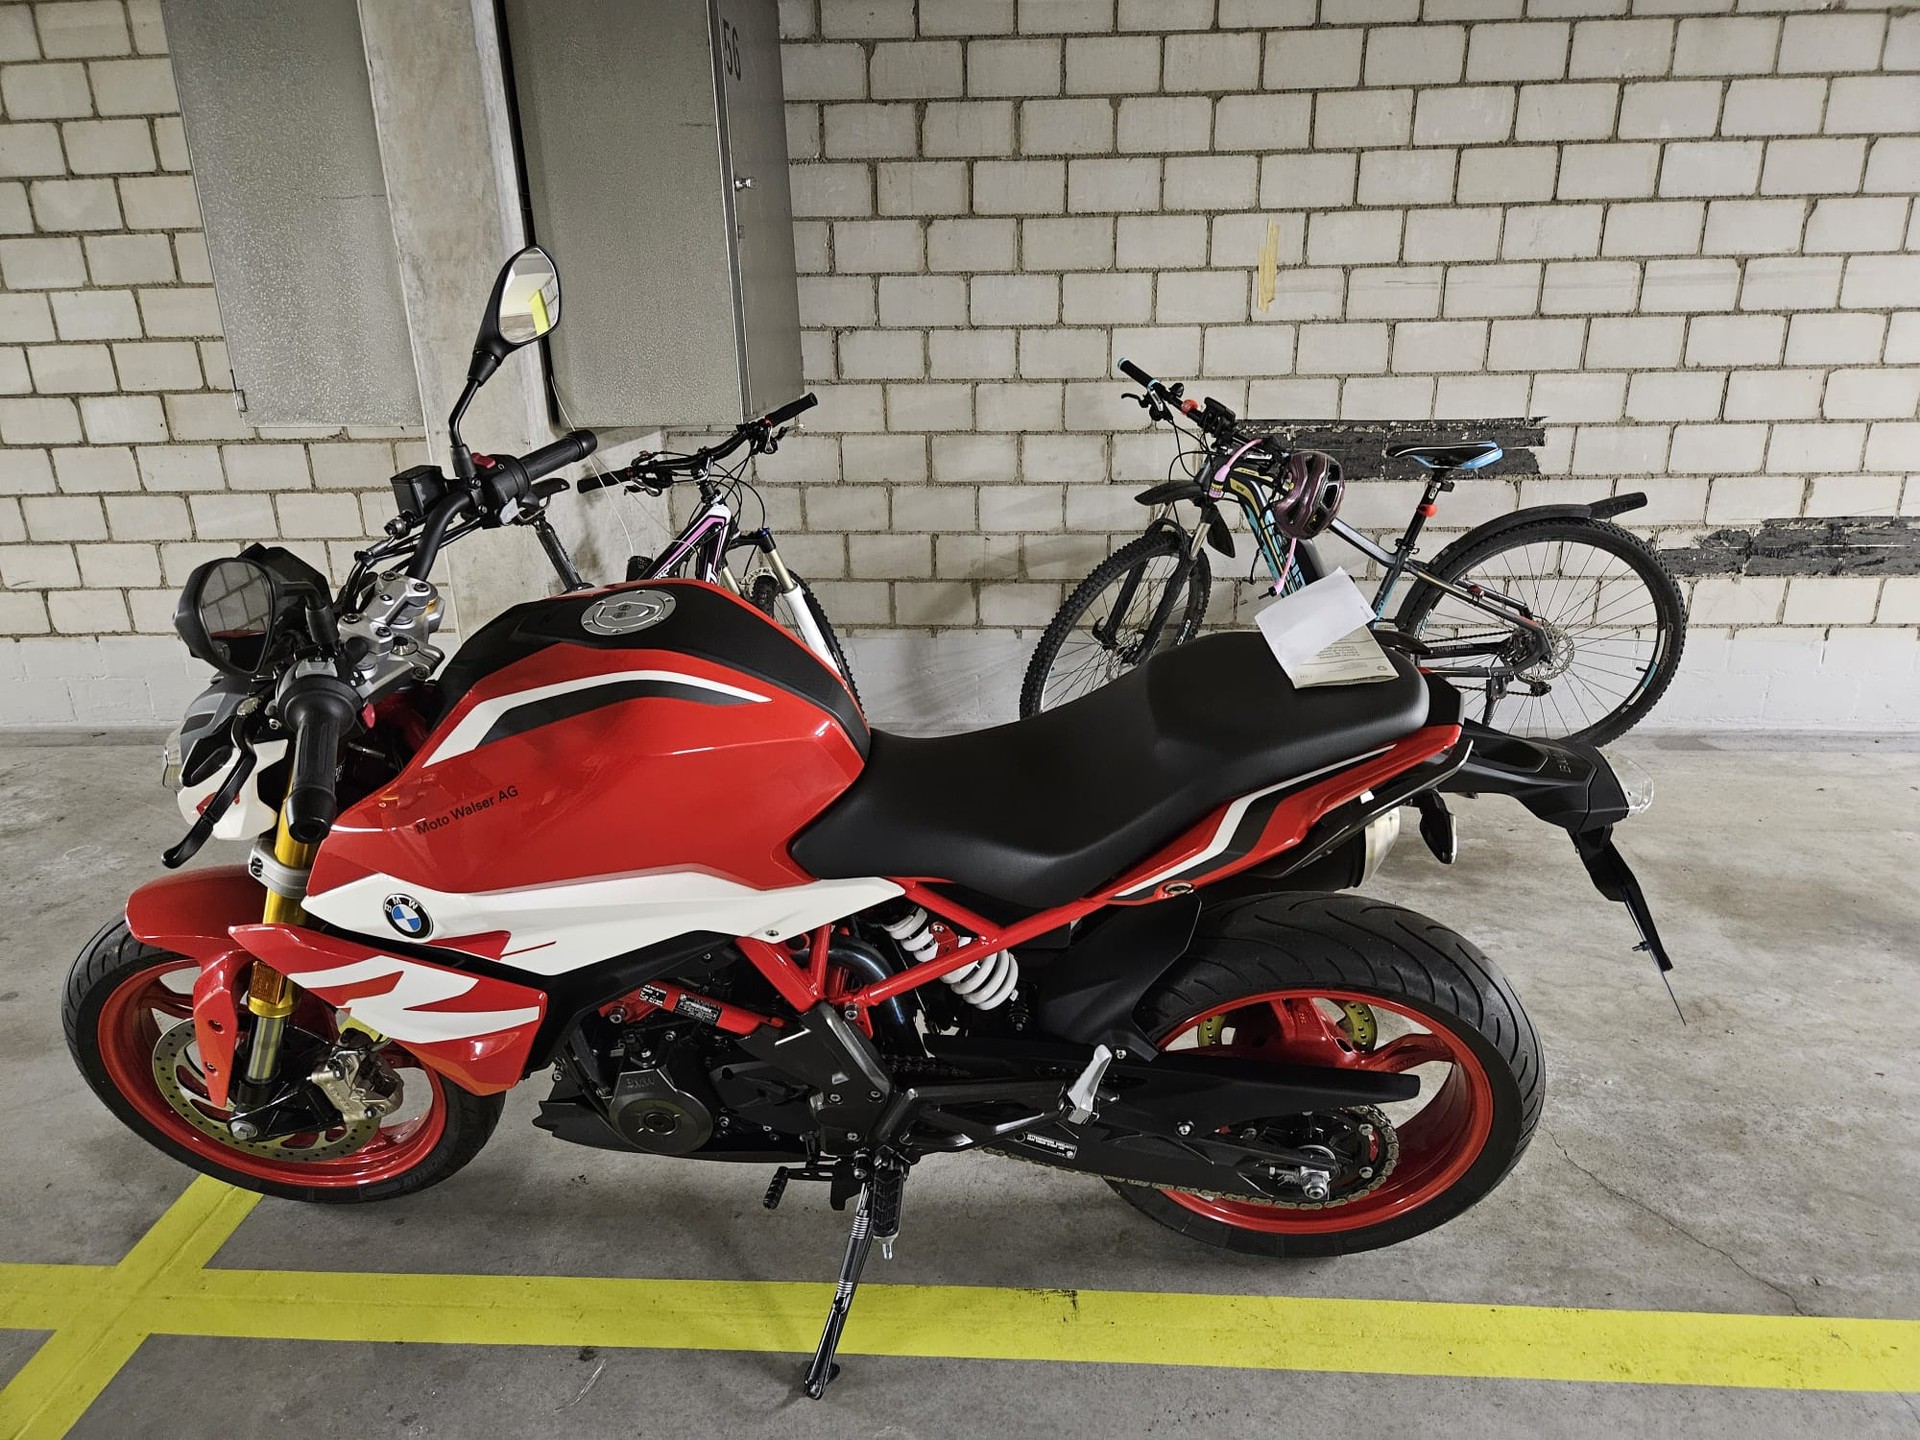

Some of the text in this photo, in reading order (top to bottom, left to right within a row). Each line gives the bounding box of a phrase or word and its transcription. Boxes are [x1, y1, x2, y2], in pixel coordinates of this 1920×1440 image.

[722, 18, 741, 81] 56
[415, 785, 519, 834] Moto Walser AG
